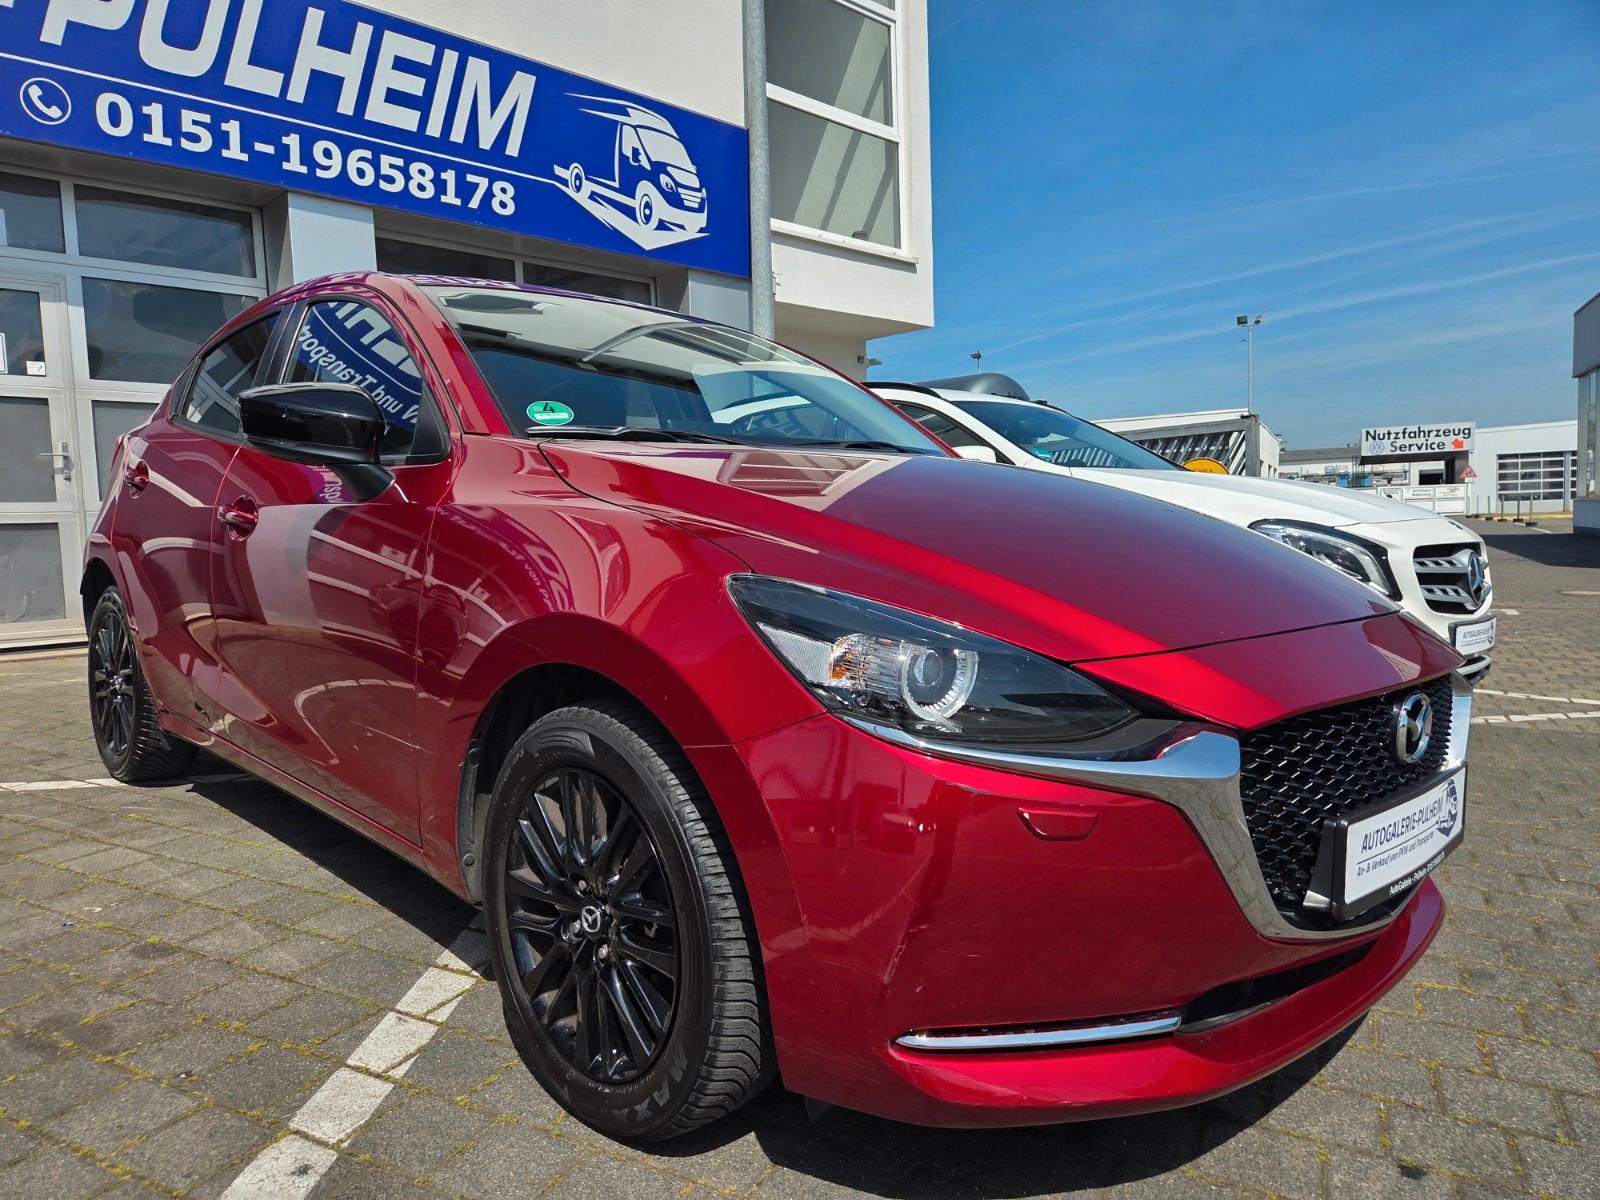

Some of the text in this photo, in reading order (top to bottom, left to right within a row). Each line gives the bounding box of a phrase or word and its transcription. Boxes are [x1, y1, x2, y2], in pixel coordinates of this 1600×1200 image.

[40, 0, 537, 157] PULHEIM
[94, 91, 517, 217] 0151-19658178
[1365, 425, 1472, 442] Nutzfahrzeug
[1389, 440, 1446, 453] Service
[1360, 796, 1444, 853] AUTOGALERIE-PULHEIM
